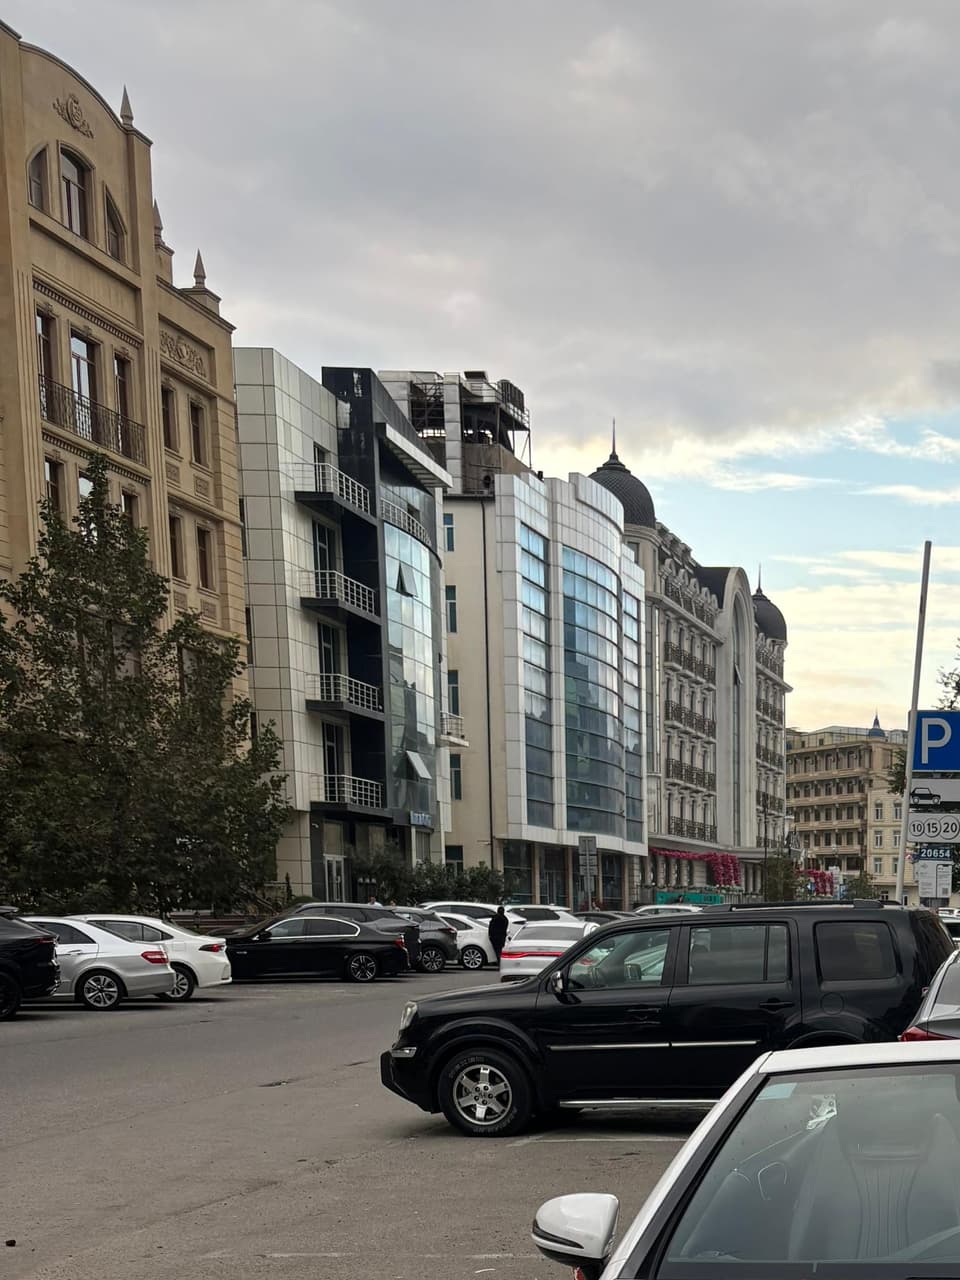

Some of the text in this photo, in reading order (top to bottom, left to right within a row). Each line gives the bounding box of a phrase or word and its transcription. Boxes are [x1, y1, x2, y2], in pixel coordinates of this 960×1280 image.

[921, 717, 952, 764] P
[912, 822, 958, 833] 10 15 20
[920, 848, 951, 858] 20654
